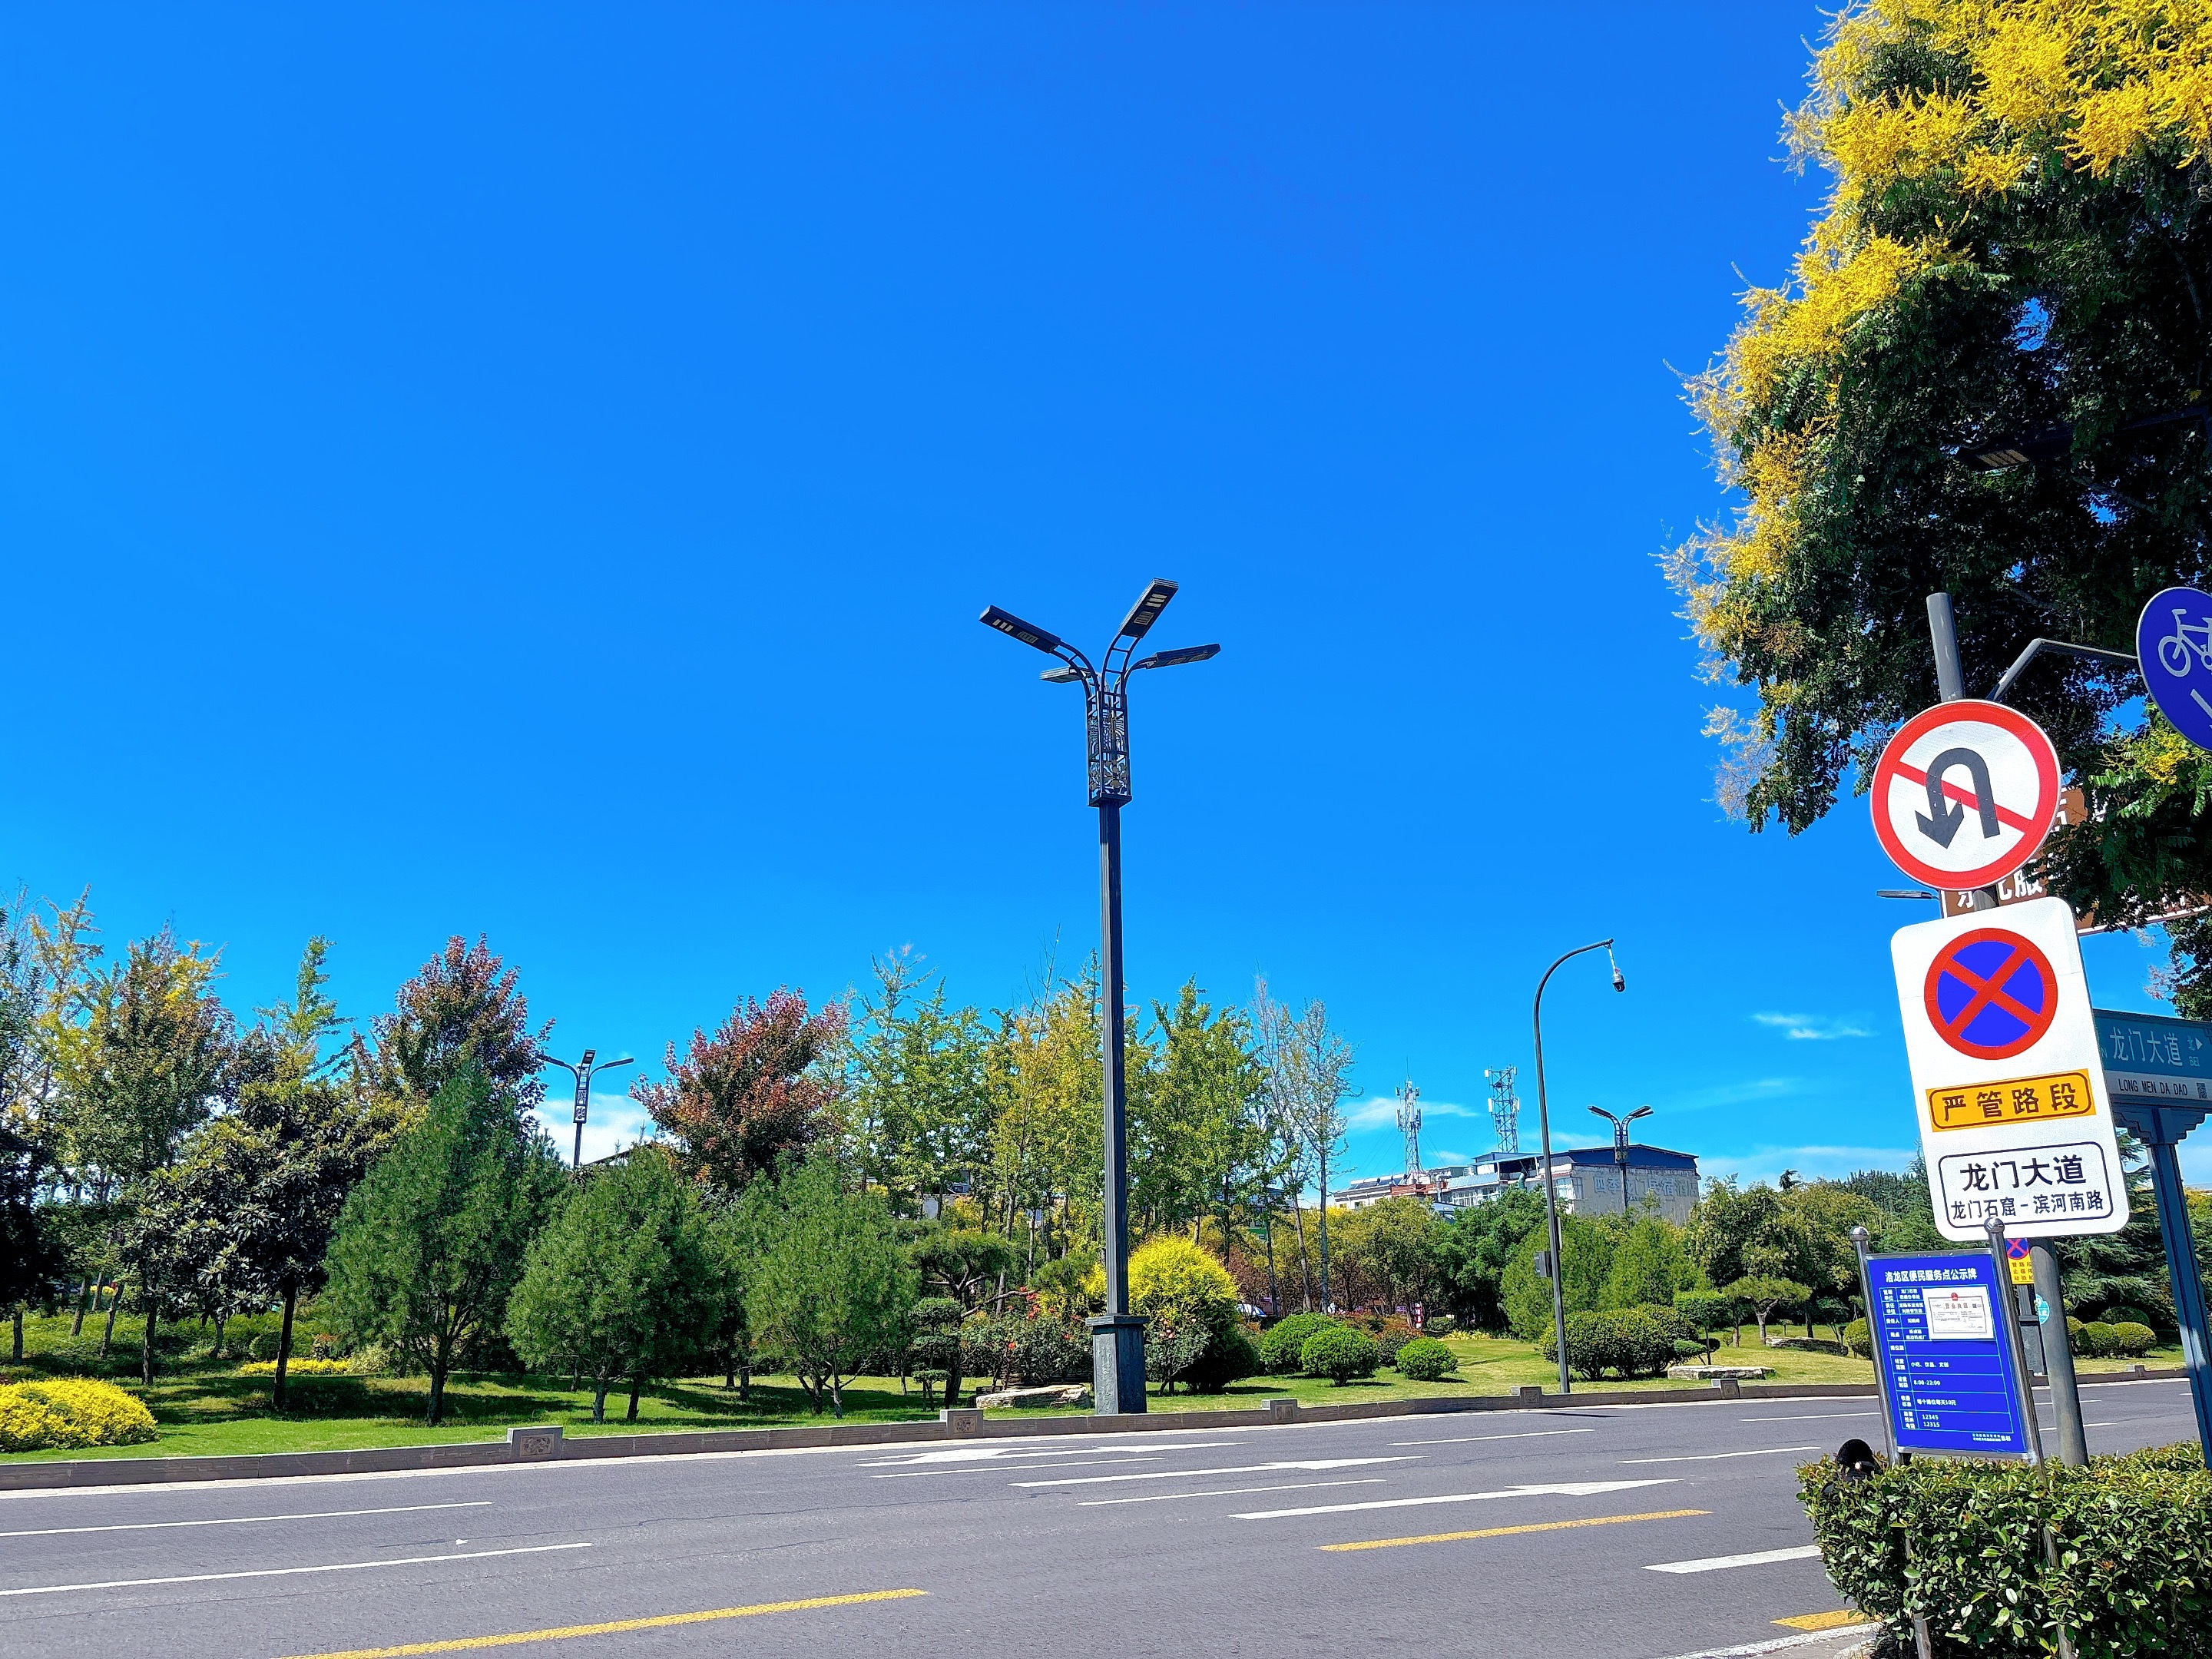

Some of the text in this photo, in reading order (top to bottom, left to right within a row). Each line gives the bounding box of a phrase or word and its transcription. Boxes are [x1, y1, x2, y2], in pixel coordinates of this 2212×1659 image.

[2109, 1026, 2183, 1066] 龙门大道
[2188, 1055, 2200, 1067] BEI
[2118, 1078, 2188, 1096] LONG MEN DA DAO
[1942, 1082, 2078, 1121] 严管路段
[1960, 1154, 2086, 1191] 龙门大道
[1884, 1267, 1978, 1283] 洛龙区便民服务点公示牌
